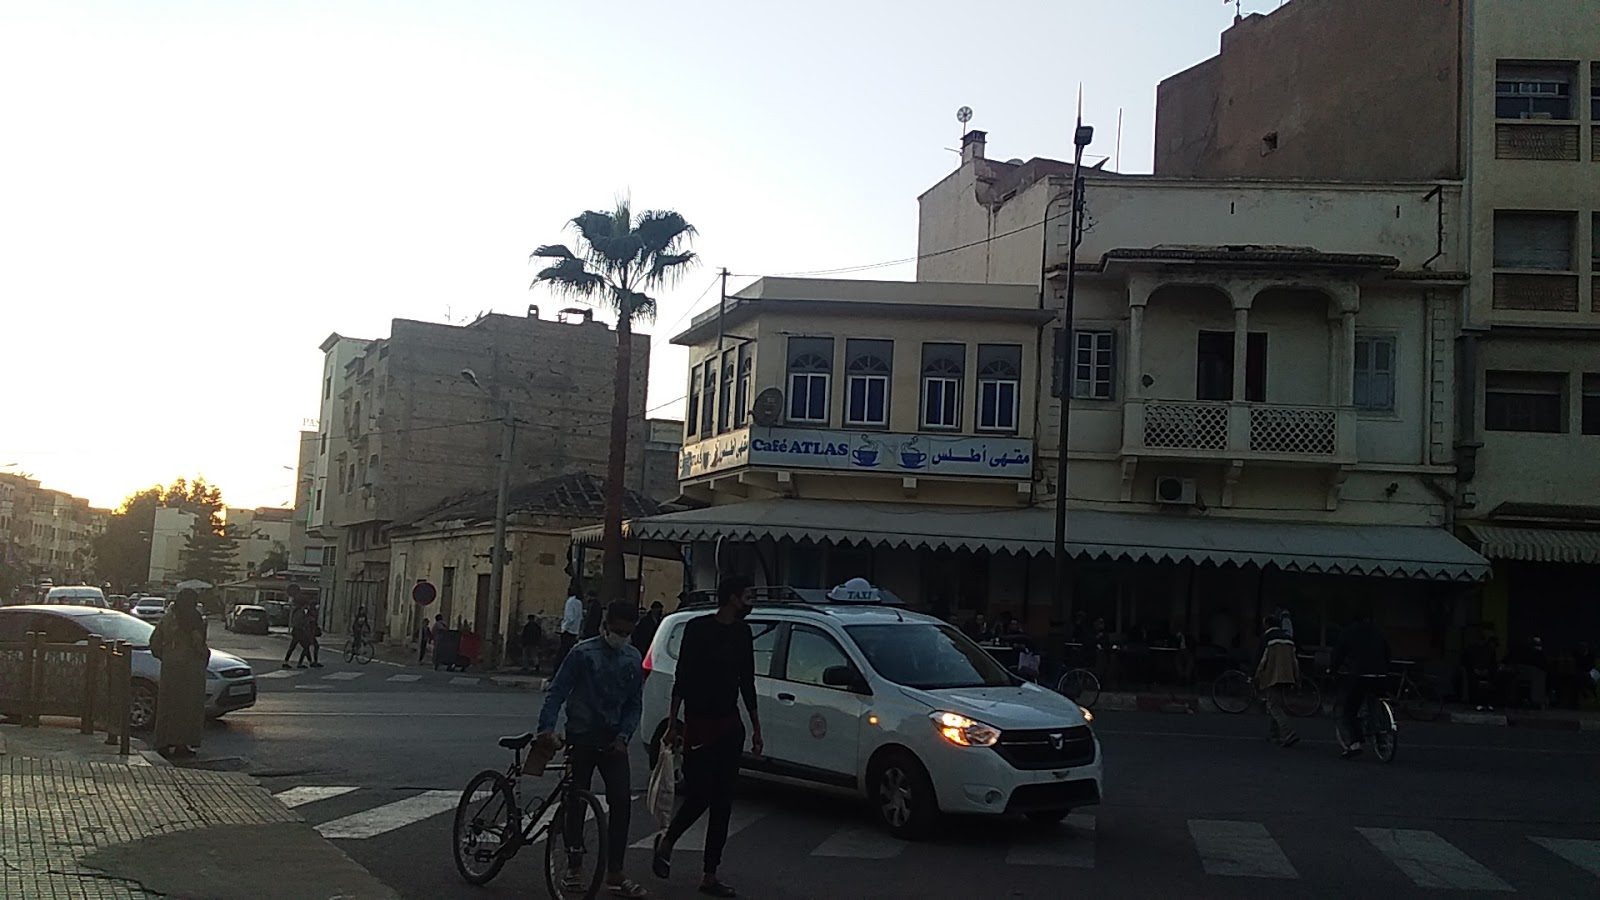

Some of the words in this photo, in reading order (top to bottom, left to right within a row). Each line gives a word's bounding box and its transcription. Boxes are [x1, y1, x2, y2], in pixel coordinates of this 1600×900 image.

[752, 438, 788, 453] Café
[788, 440, 849, 456] ATLAS
[931, 444, 987, 465] أطلس
[988, 448, 1030, 468] مقهى
[847, 590, 872, 600] TAXI
